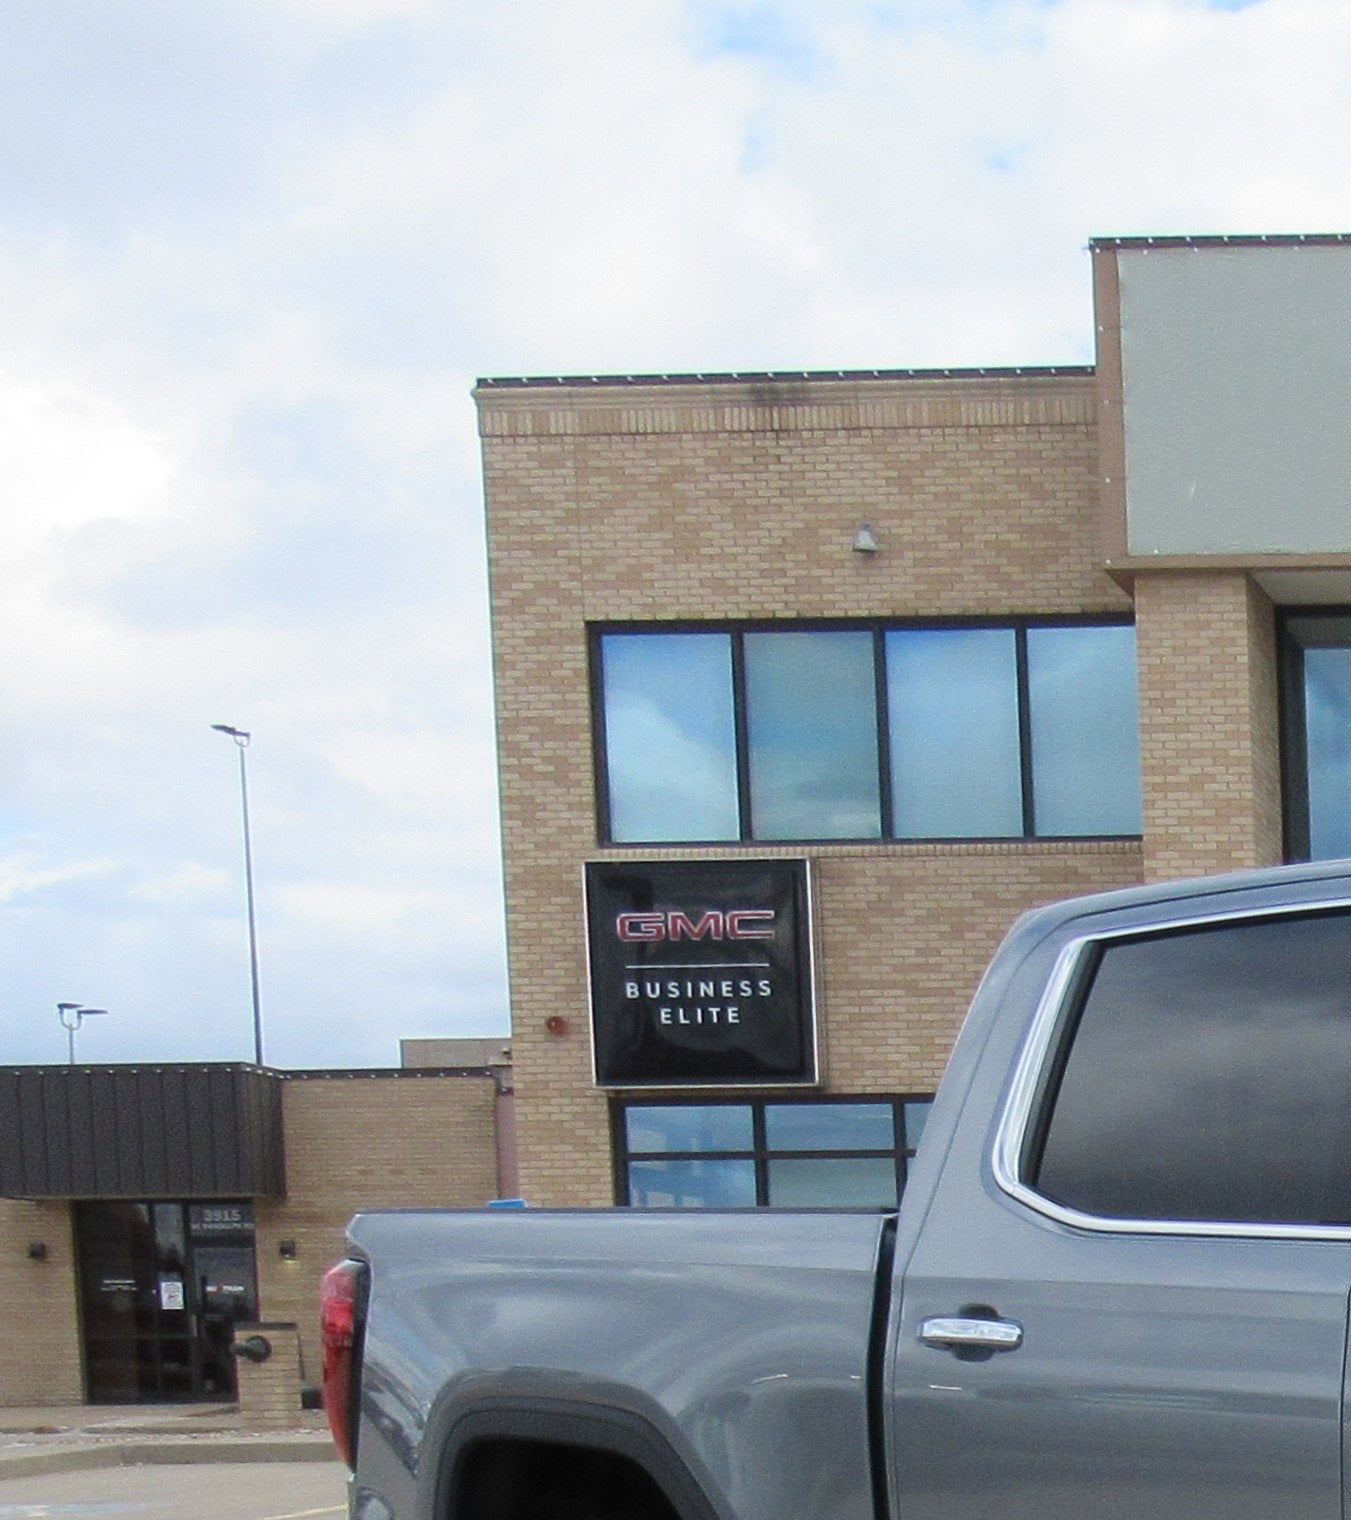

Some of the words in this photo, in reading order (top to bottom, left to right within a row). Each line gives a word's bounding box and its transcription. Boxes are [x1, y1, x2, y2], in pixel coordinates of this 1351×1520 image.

[616, 909, 776, 942] GMC
[624, 979, 772, 999] BUSINESS
[659, 1006, 741, 1024] ELITE
